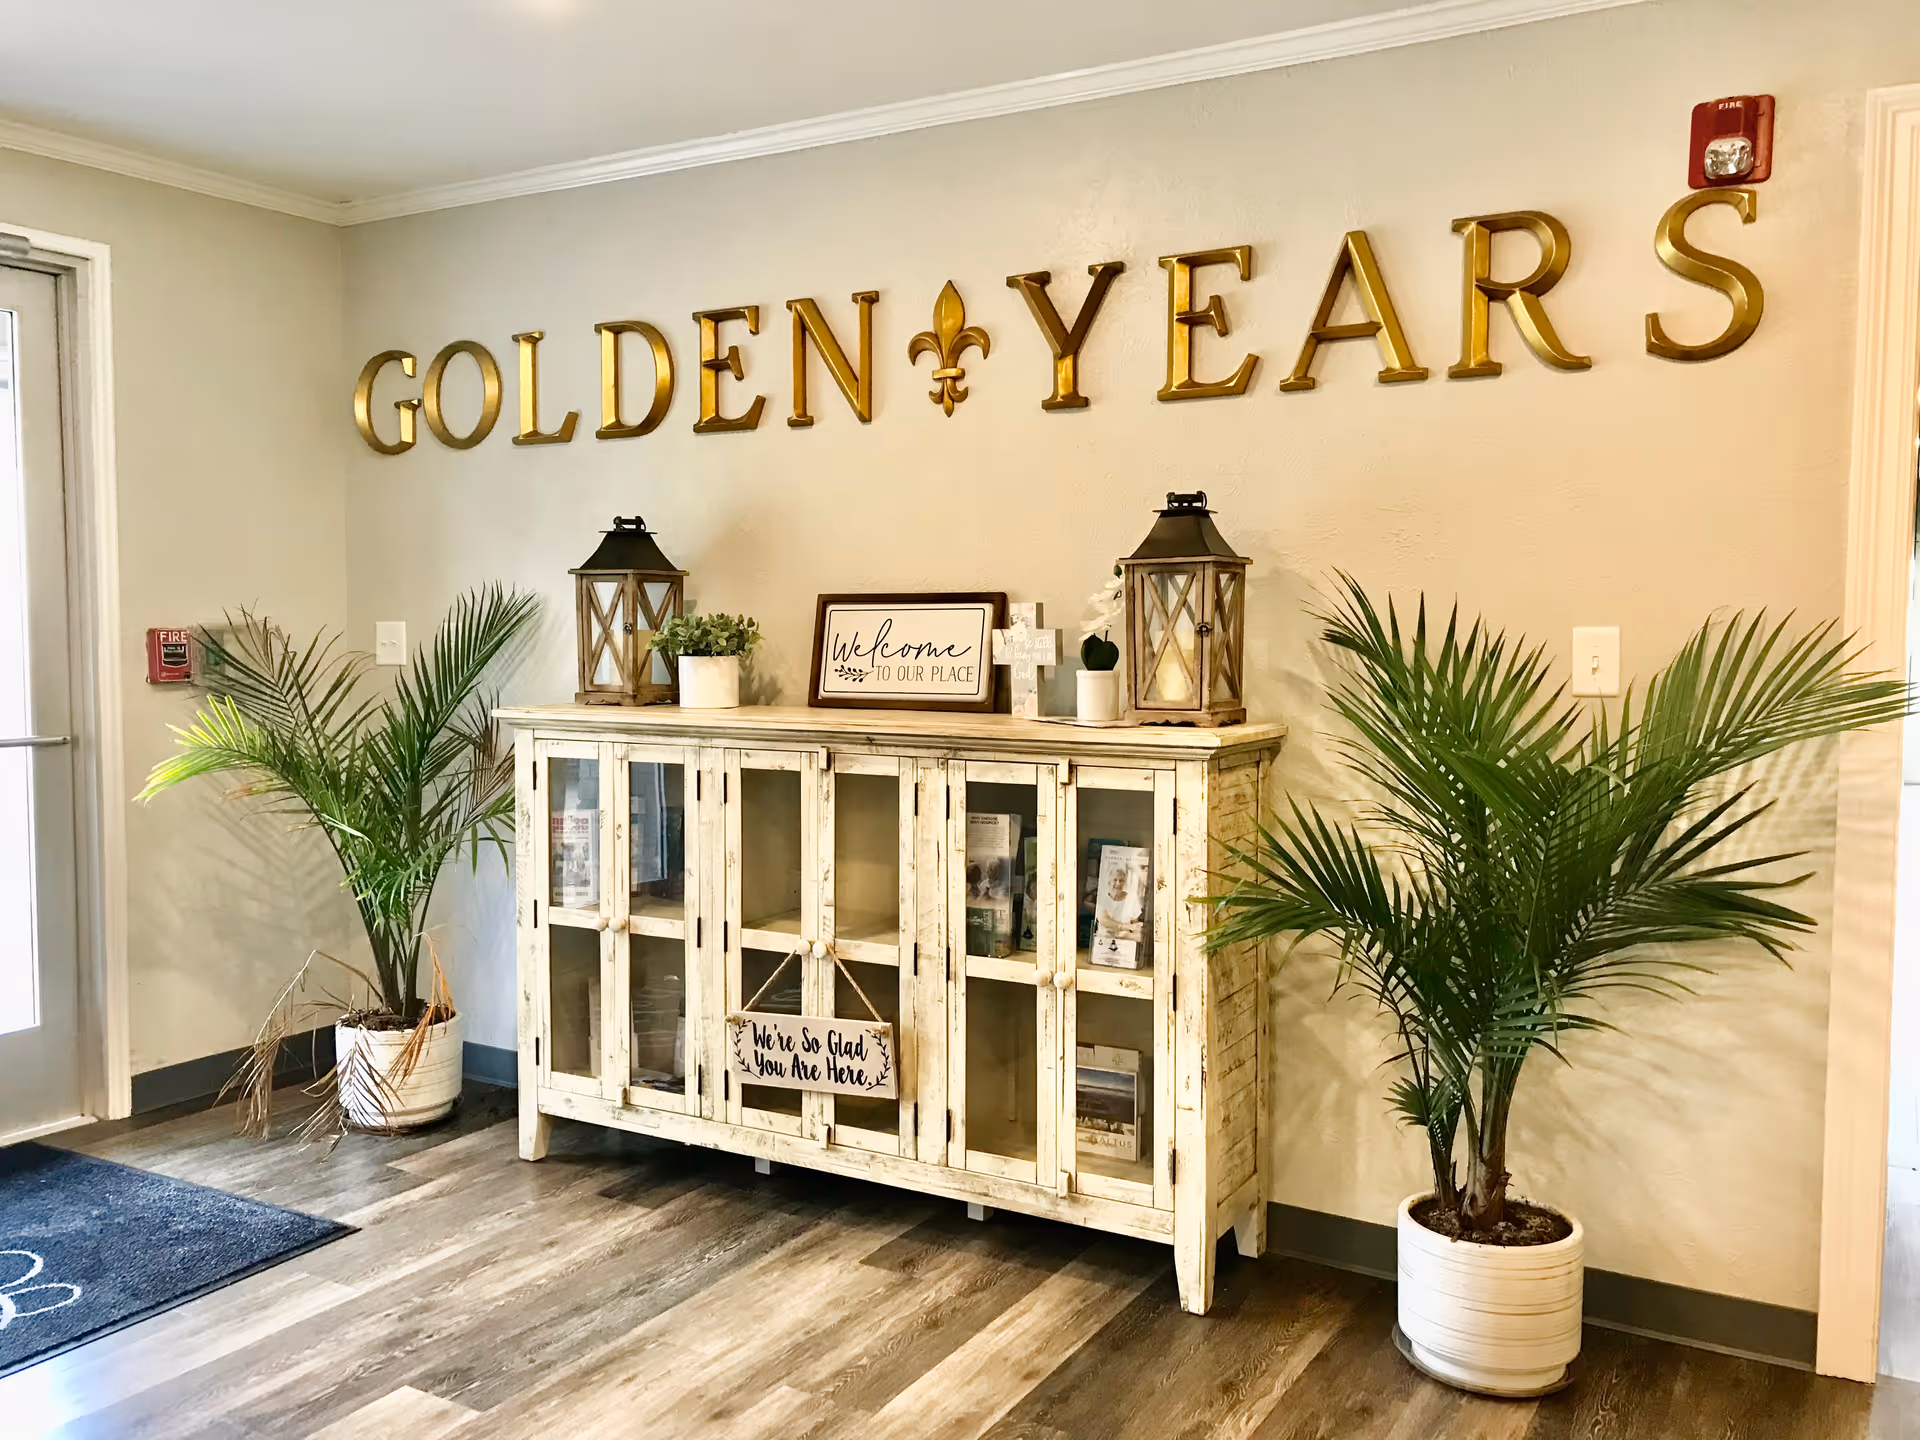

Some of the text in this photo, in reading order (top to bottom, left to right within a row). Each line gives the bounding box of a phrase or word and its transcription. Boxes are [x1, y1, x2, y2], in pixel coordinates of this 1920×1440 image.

[1718, 100, 1743, 110] FIRE
[354, 187, 1765, 455] GOLDEN YEARS
[160, 631, 188, 642] FIRE
[832, 618, 972, 668] Welcome
[875, 665, 974, 683] TO OUR PLACE
[752, 1022, 868, 1062] We're So Glad
[753, 1049, 873, 1087] You Are Here.
